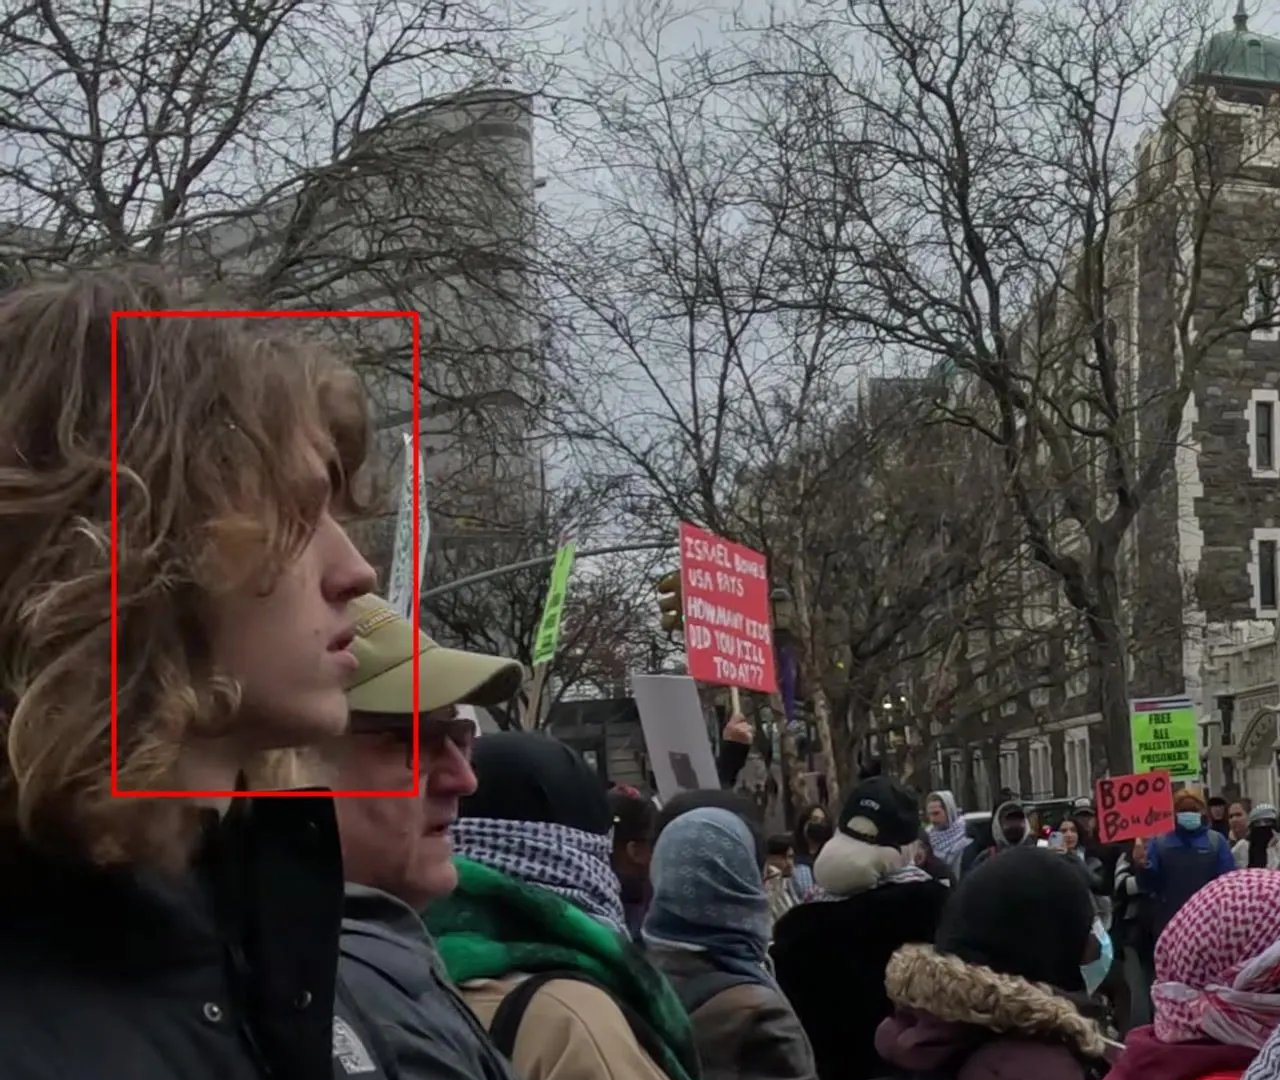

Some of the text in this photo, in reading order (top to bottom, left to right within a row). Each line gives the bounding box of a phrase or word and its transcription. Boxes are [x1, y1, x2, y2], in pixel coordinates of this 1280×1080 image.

[685, 537, 732, 568] ISRAEL
[688, 568, 744, 597] USA PAYS
[688, 596, 716, 624] HOW
[745, 619, 770, 645] KIDS
[689, 624, 766, 665] DID YOU KILL
[1148, 712, 1172, 725] FREE
[1153, 728, 1170, 740] ALL
[1138, 739, 1190, 751] PALESTINIAN
[1140, 751, 1189, 764] PRISONERS
